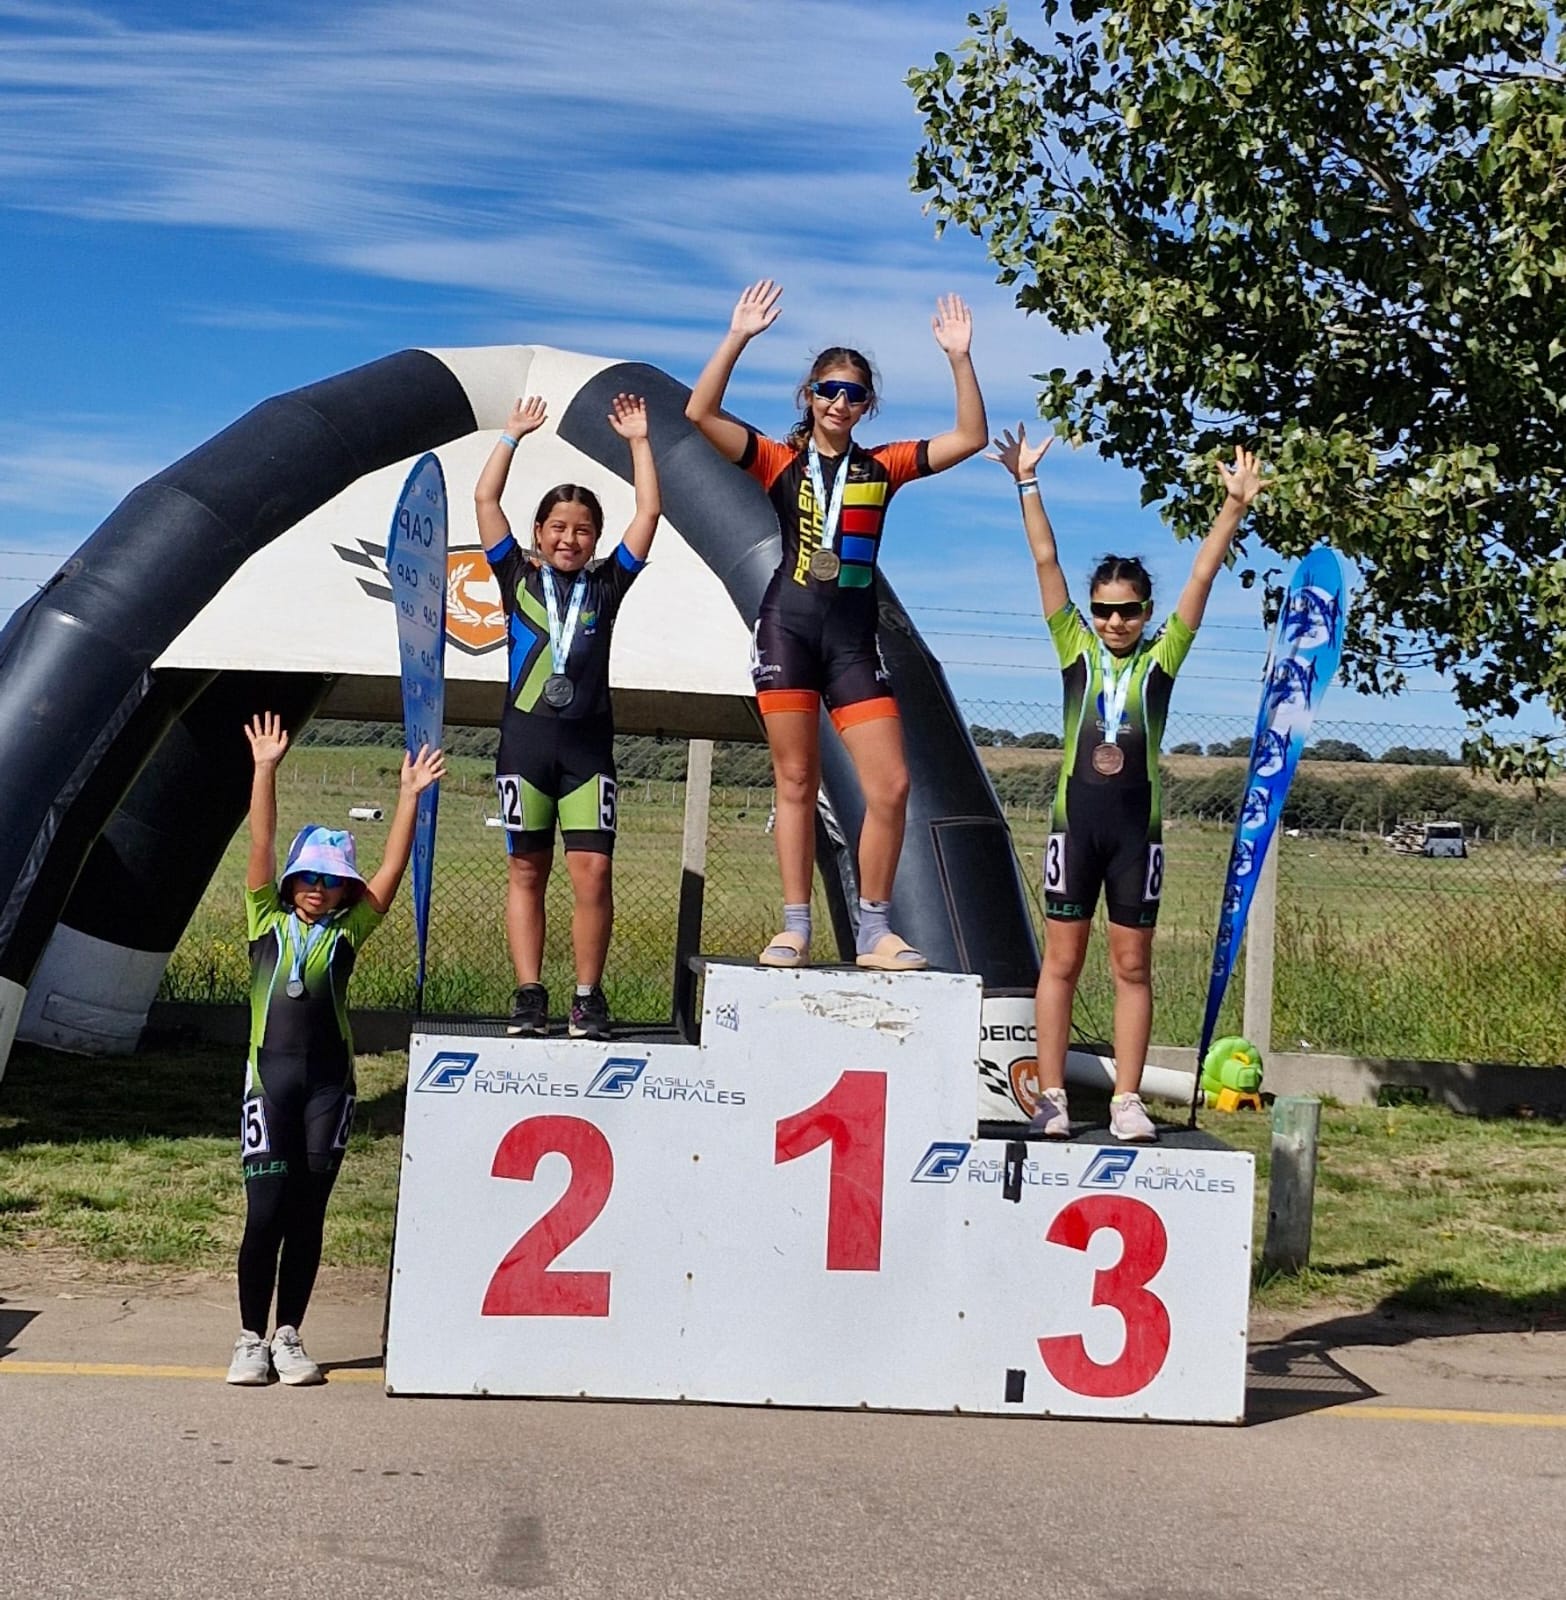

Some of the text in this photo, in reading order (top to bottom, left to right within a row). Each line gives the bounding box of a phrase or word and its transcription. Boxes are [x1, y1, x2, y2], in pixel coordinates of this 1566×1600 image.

[602, 781, 617, 829] 5
[1047, 838, 1061, 887] 3
[1149, 847, 1162, 897] 8
[474, 1080, 580, 1098] RURALES
[475, 1069, 549, 1082] CASILLAS
[642, 1086, 746, 1105] RURALES
[643, 1075, 716, 1089] CASILLAS
[775, 1069, 888, 1272] 1
[1135, 1176, 1236, 1194] RURALES
[481, 1114, 614, 1317] 2
[1037, 1194, 1170, 1398] 3
